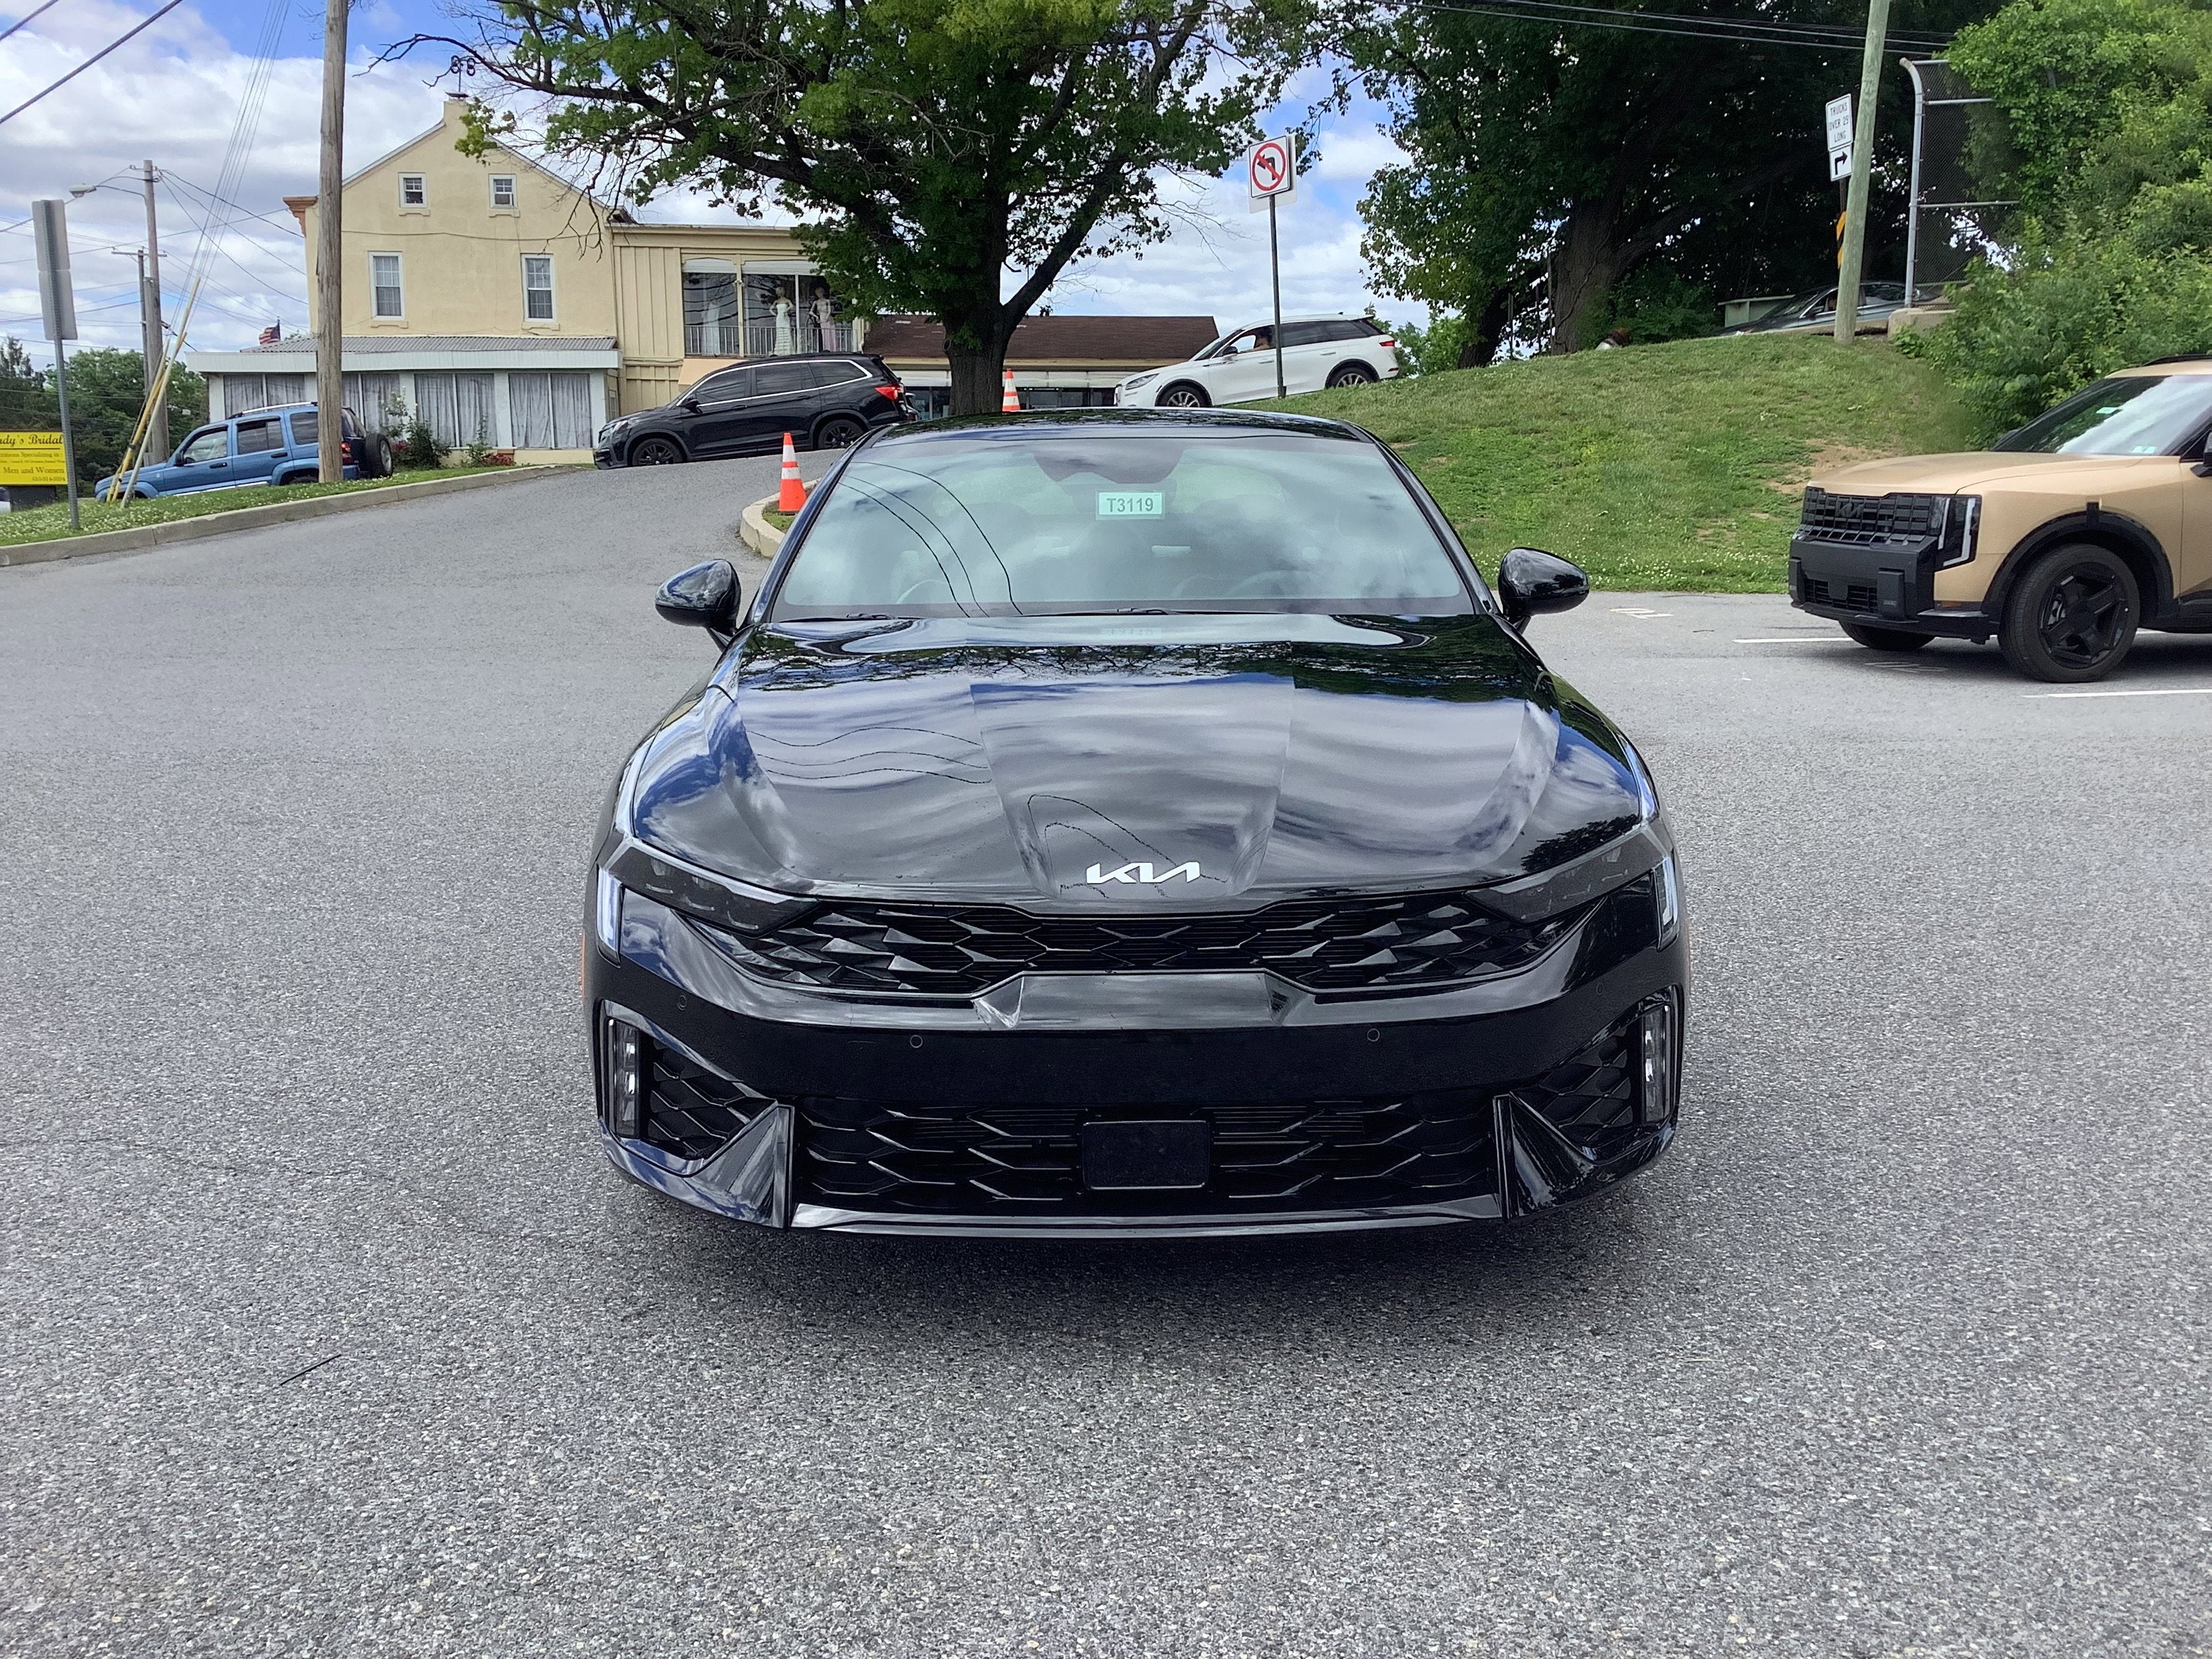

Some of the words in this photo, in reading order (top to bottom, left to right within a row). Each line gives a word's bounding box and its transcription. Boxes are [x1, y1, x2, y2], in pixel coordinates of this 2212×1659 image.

[1830, 102, 1847, 116] TRUCKS
[1829, 119, 1841, 131] OVER
[1834, 130, 1846, 142] LONG
[28, 434, 64, 445] Bridal
[1107, 497, 1153, 512] T3119
[1086, 861, 1200, 884] KIA
